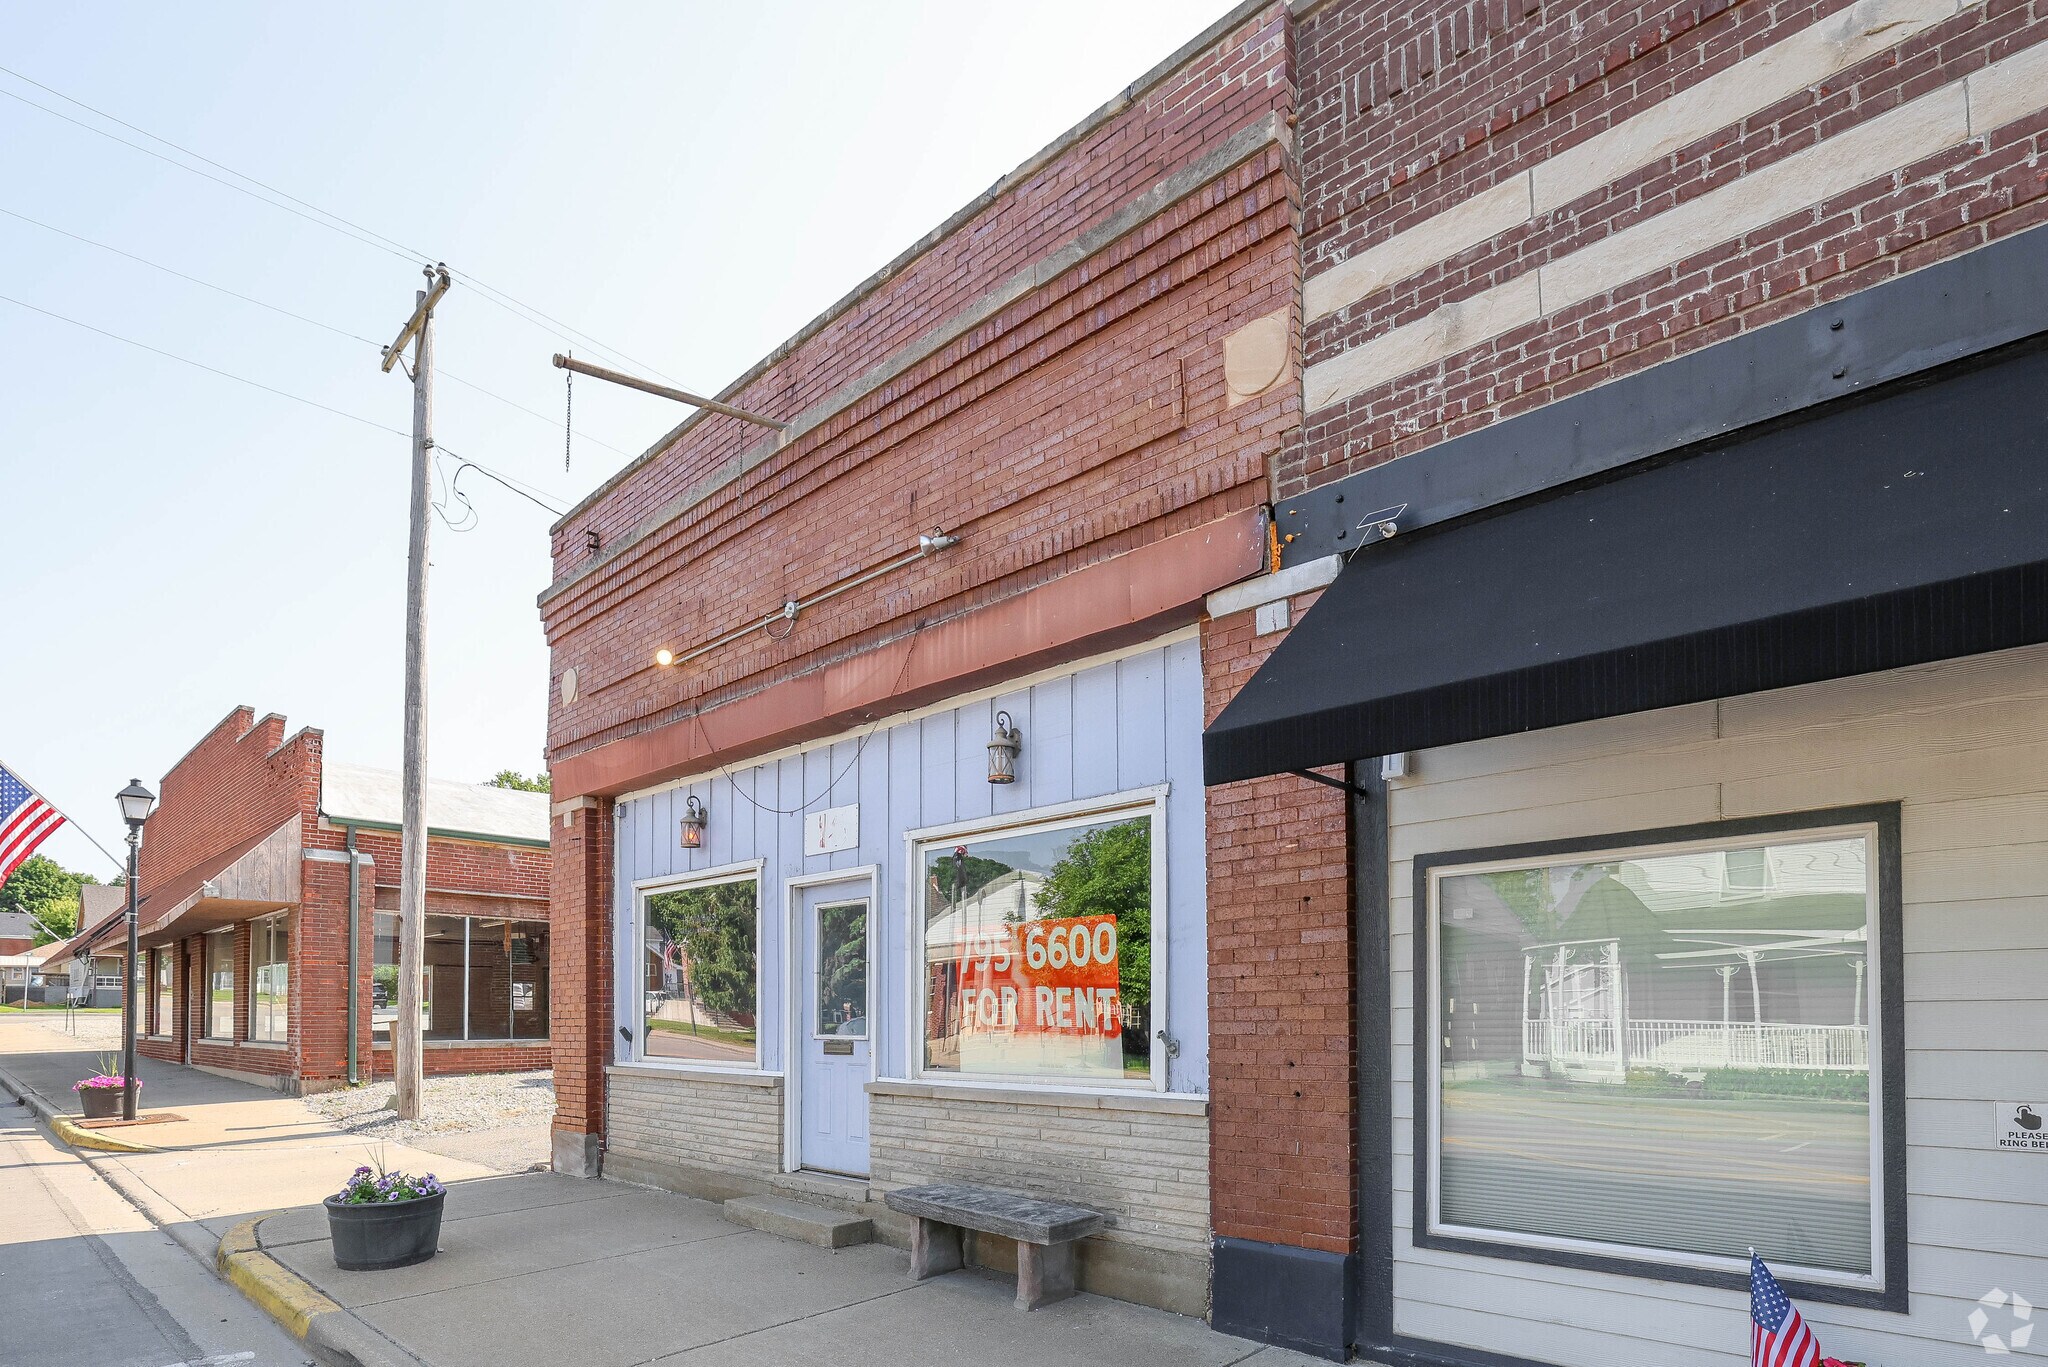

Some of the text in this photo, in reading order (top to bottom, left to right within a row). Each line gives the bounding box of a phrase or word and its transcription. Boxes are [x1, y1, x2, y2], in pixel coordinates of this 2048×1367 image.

[961, 922, 1117, 974] 795 6600
[961, 985, 1117, 1031] FOR RENT
[1999, 1139, 2028, 1147] RING
[2008, 1131, 2048, 1139] PLEASE
